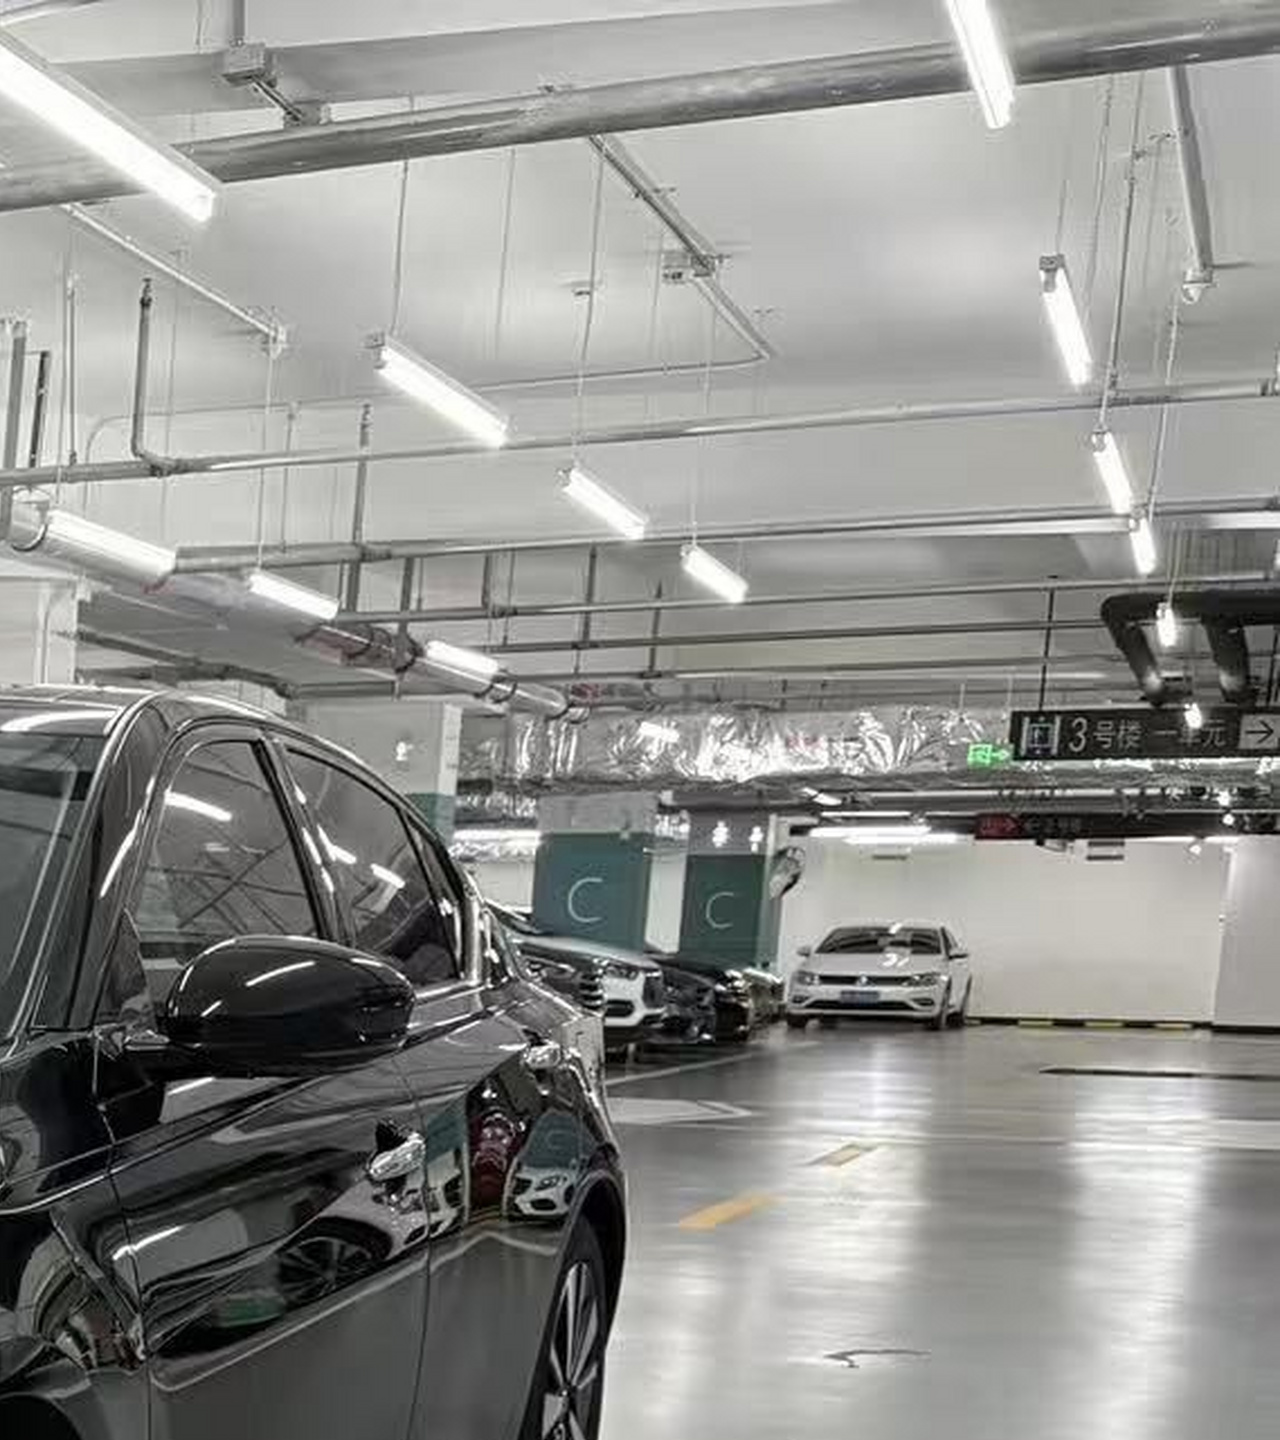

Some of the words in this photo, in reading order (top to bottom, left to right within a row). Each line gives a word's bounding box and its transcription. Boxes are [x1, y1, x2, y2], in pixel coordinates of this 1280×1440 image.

[1068, 716, 1142, 752] 3号楼
[568, 876, 603, 923] C
[706, 891, 735, 929] C
